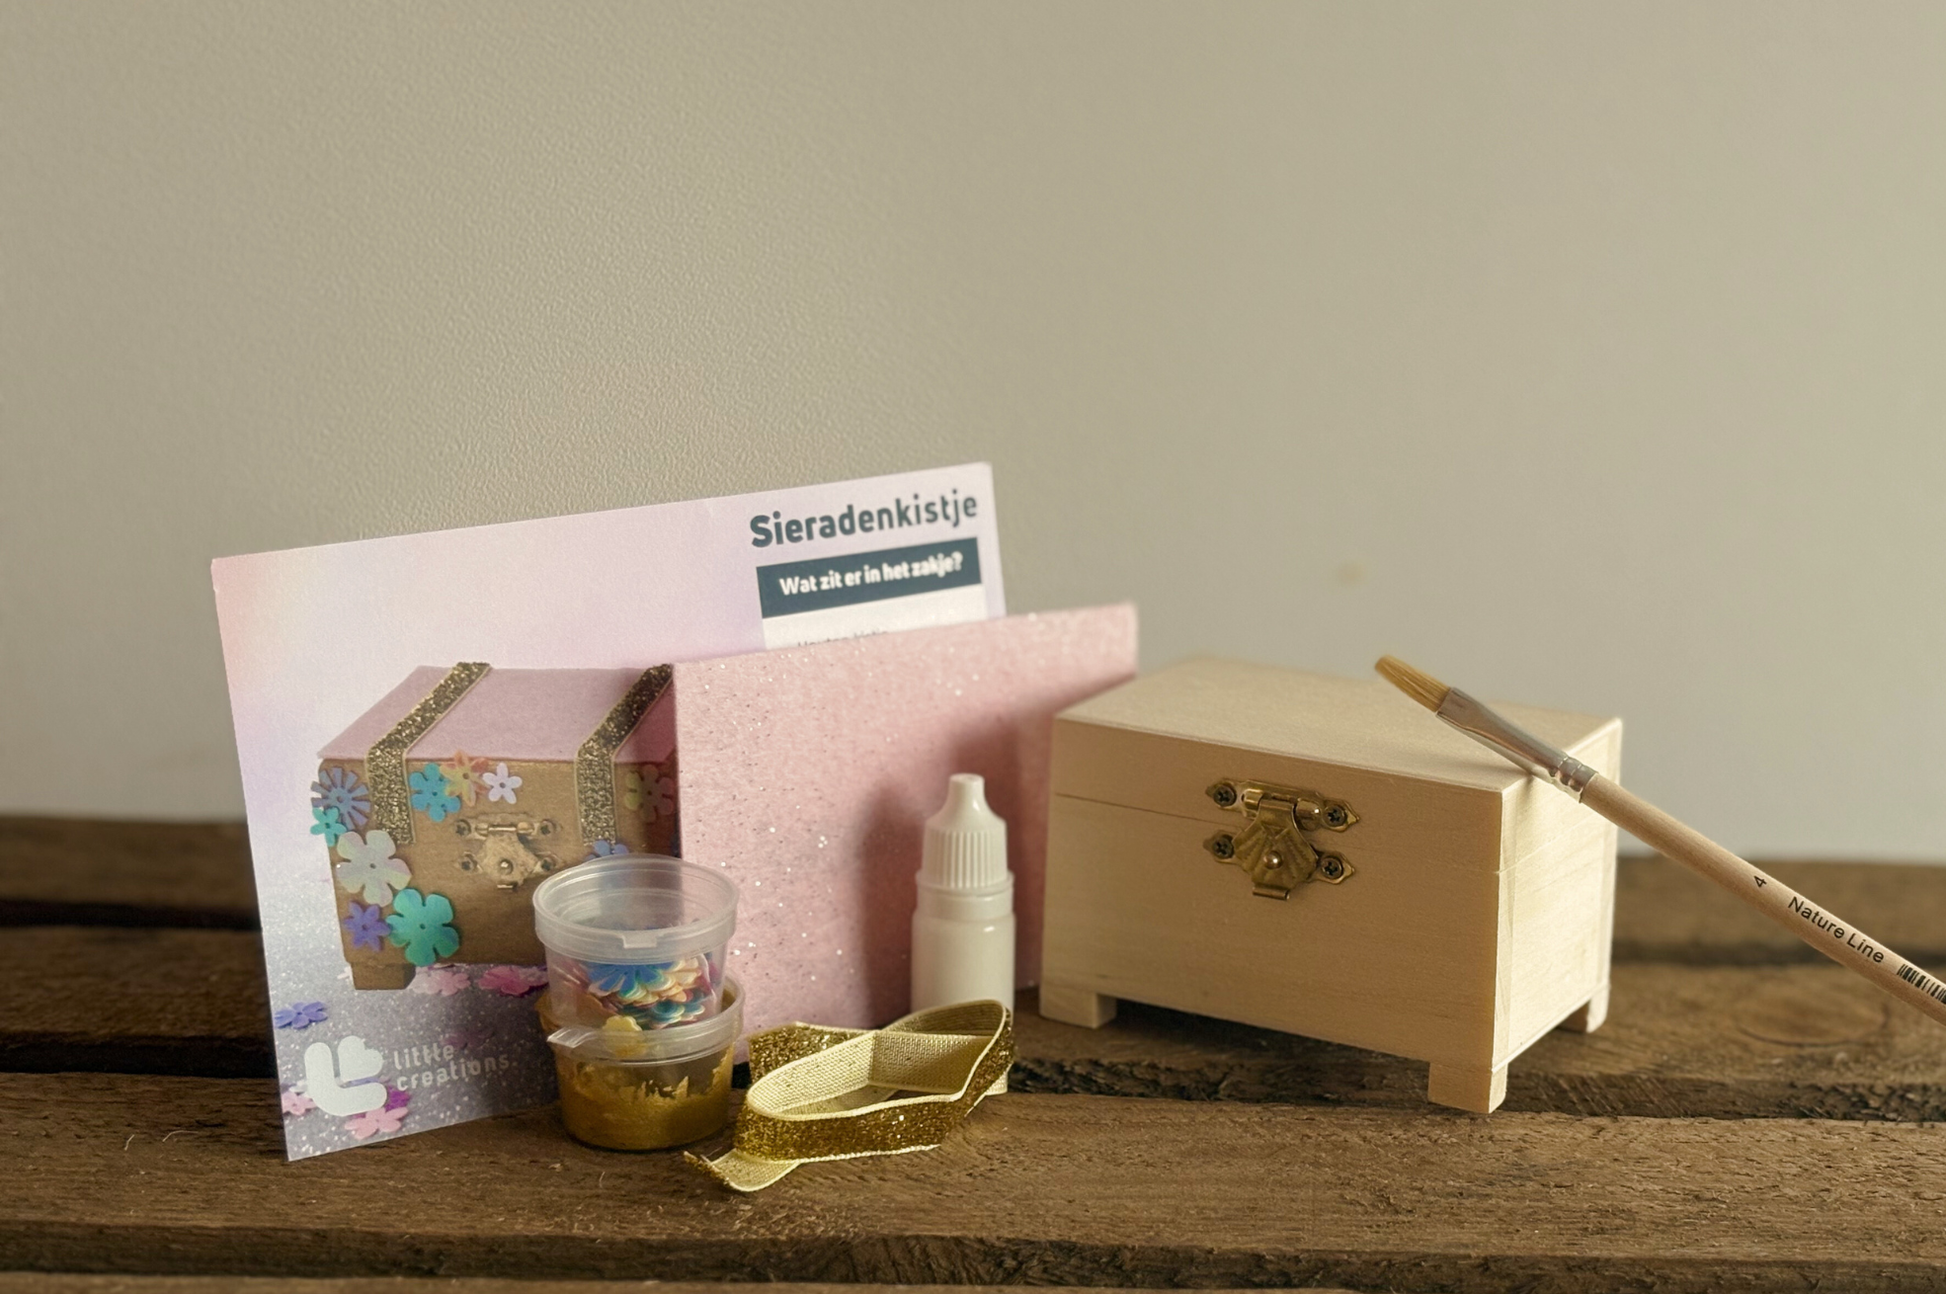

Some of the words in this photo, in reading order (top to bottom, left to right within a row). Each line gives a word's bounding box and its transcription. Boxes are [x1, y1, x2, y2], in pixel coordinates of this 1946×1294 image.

[750, 488, 977, 547] Sieradenkistje
[779, 576, 818, 595] Wat
[820, 570, 843, 589] zit
[844, 572, 862, 587] er
[863, 565, 881, 583] in
[882, 559, 910, 580] het
[910, 551, 963, 577] zakje?
[1754, 876, 1767, 887] 4
[1788, 897, 1844, 938] Nature
[1847, 933, 1884, 962] Line
